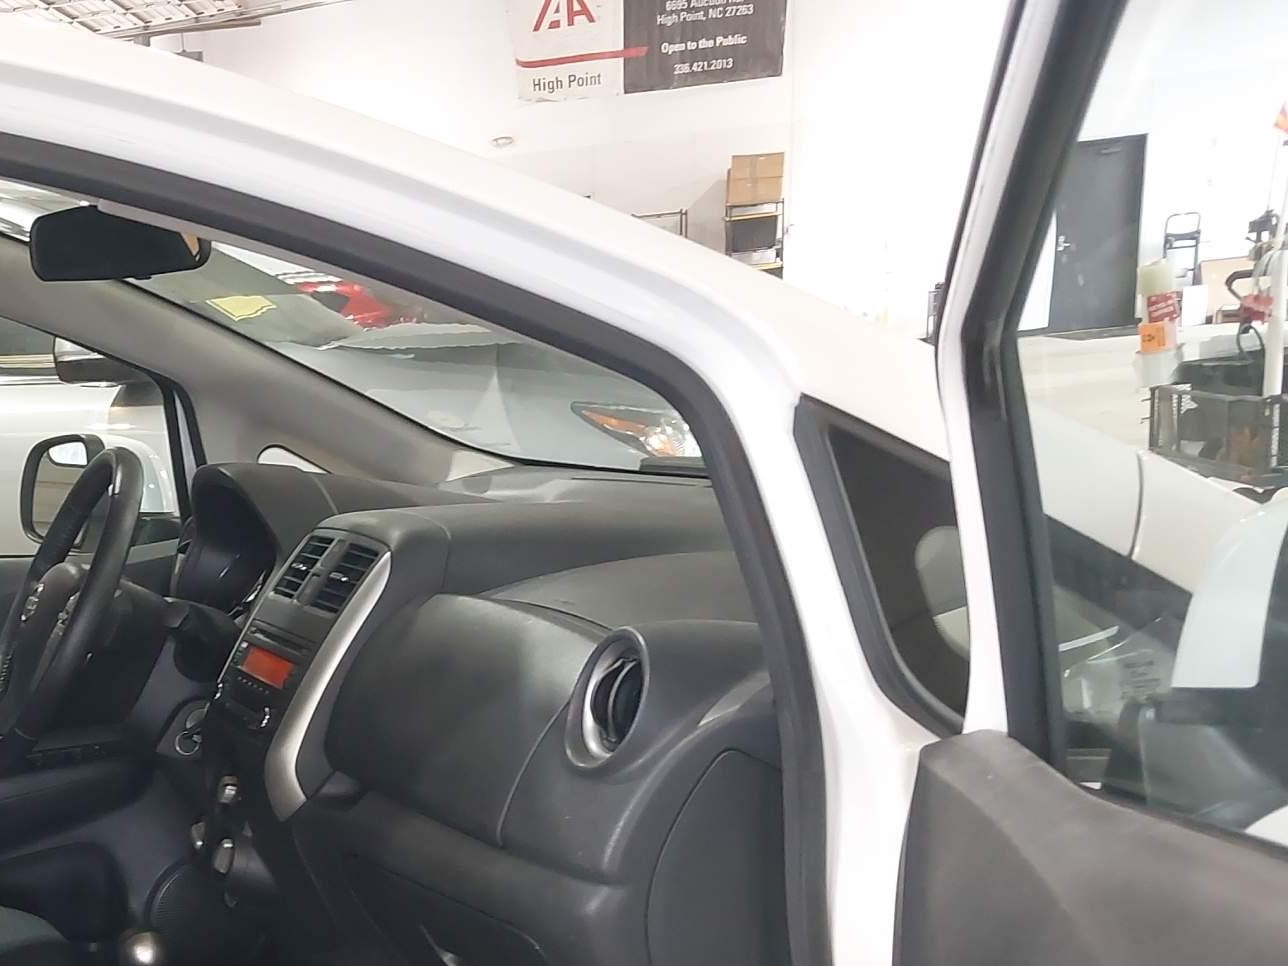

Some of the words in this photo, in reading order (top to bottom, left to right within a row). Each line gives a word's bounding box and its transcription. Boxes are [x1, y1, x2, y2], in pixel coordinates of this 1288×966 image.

[657, 13, 679, 26] High
[708, 9, 723, 18] NC
[661, 42, 685, 55] Open
[687, 41, 697, 50] to
[698, 38, 714, 49] the
[716, 34, 747, 46] Public
[532, 76, 563, 94] High
[568, 72, 601, 88] Point
